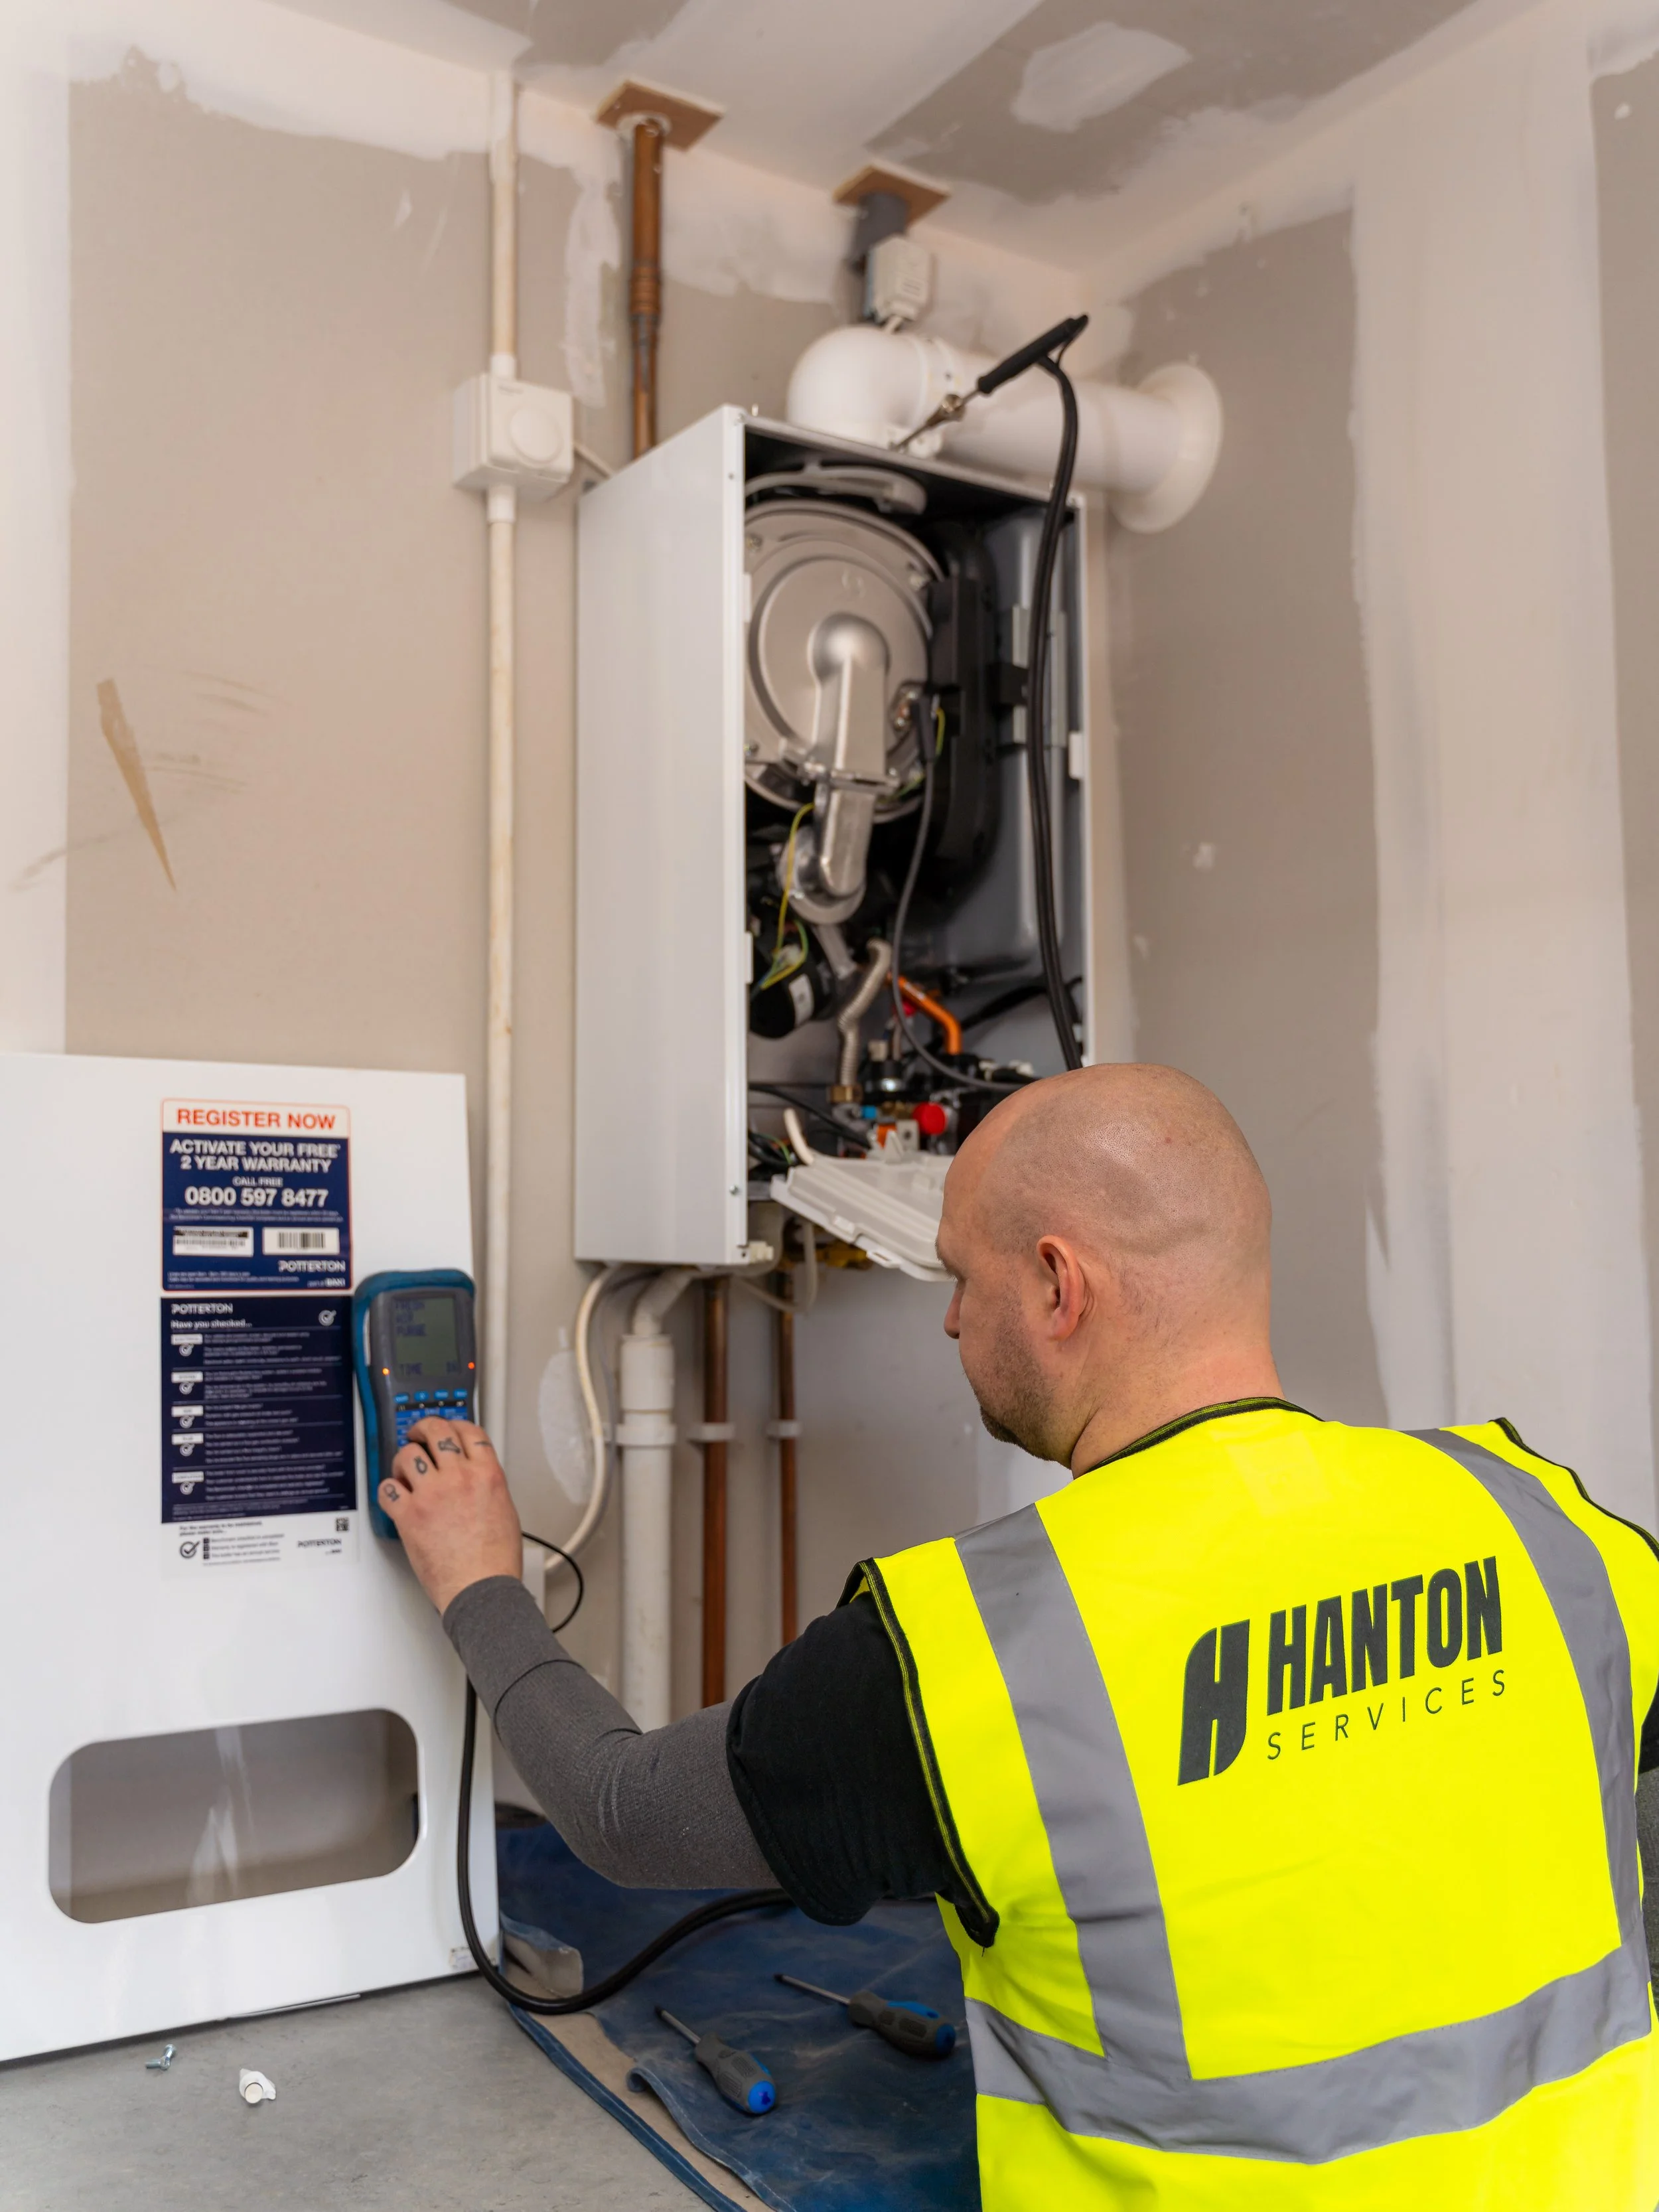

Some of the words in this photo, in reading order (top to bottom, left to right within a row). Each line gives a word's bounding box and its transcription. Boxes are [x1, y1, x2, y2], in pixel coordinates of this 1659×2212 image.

[177, 1108, 280, 1128] REGISTER
[288, 1113, 335, 1129] NOW
[169, 1139, 246, 1155] ACTIVATE
[249, 1141, 294, 1157] YOUR
[180, 1155, 192, 1170] 2
[194, 1155, 240, 1171] YEAR
[242, 1157, 332, 1173] WARRANTY
[232, 1177, 256, 1187] CALL
[257, 1177, 283, 1187] FREE
[184, 1186, 236, 1206] 0800
[240, 1187, 277, 1207] 597
[281, 1188, 328, 1207] 8477
[278, 1260, 346, 1272] POTTERTON
[171, 1303, 233, 1315] POTTERTON
[171, 1319, 192, 1328] Have
[193, 1321, 210, 1330] you
[1267, 1556, 1502, 1716] HANTON
[1267, 1669, 1505, 1760] SERVICES
